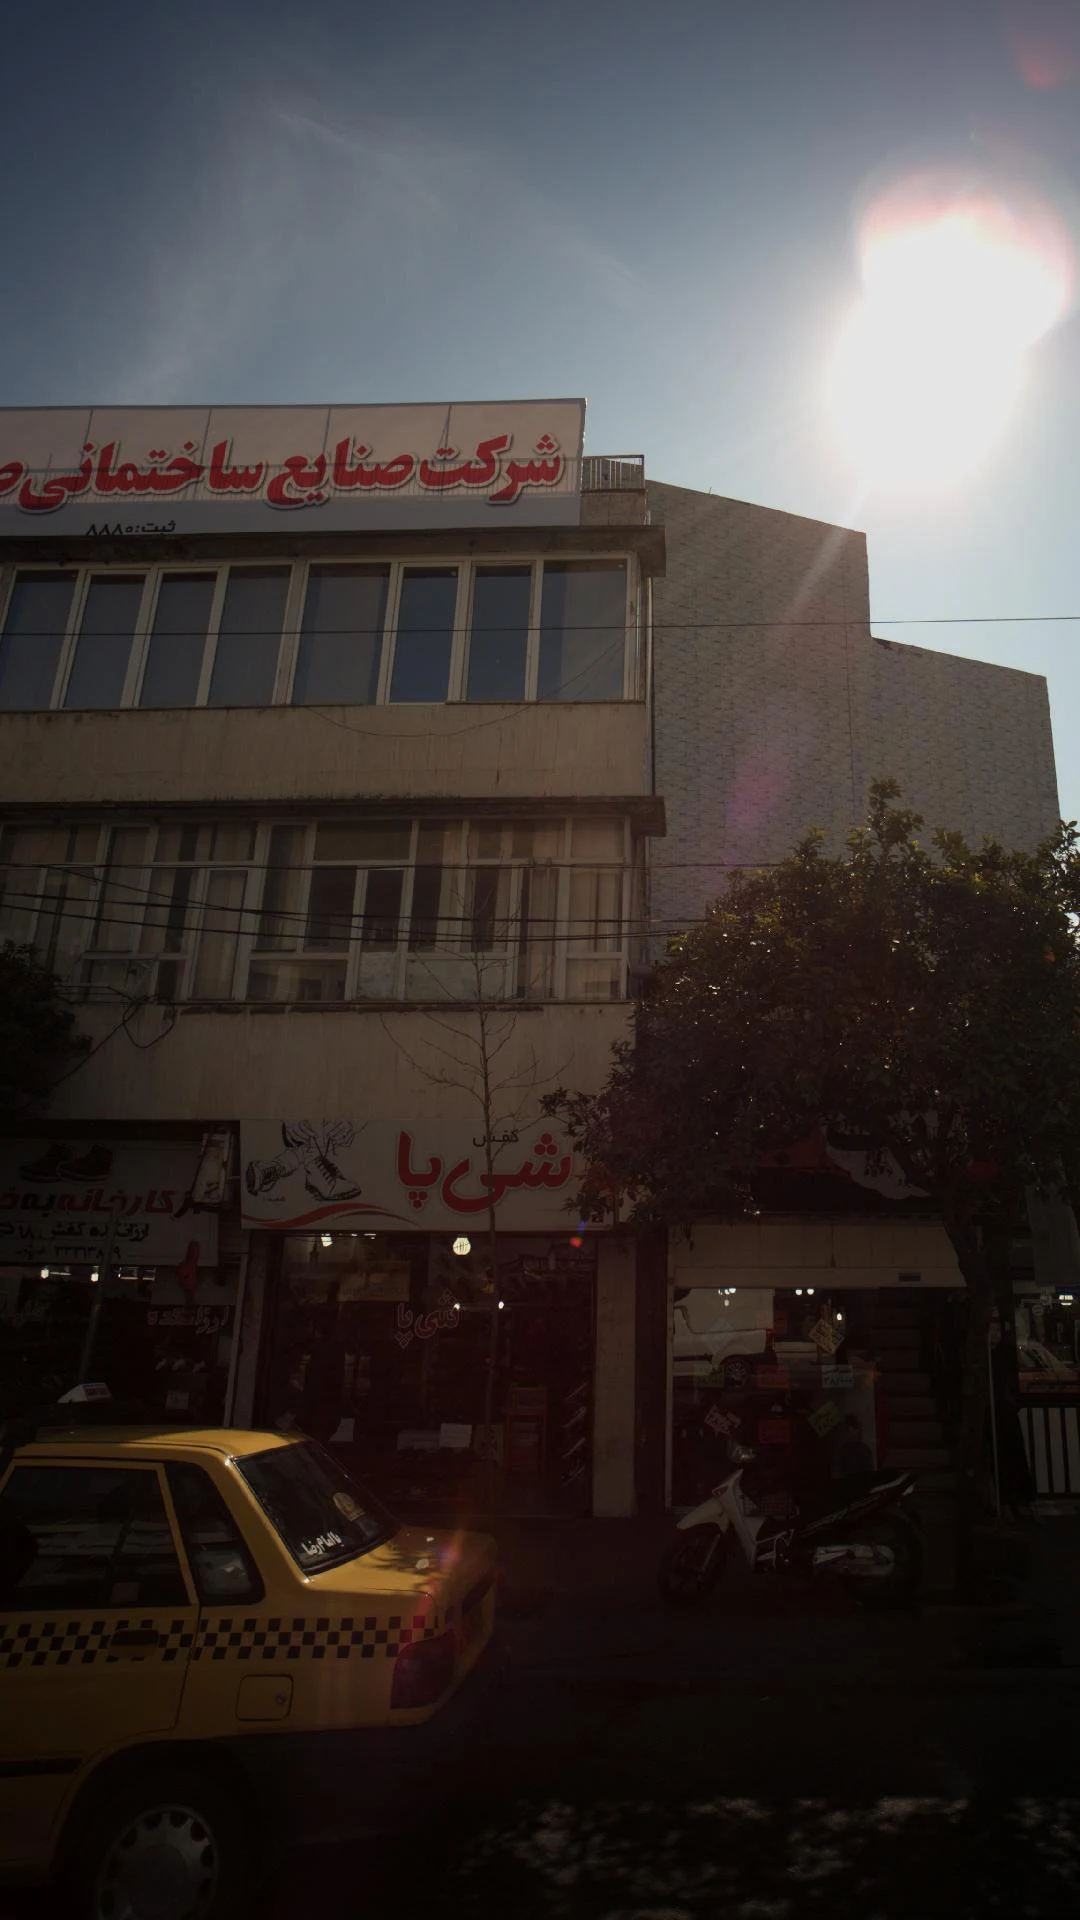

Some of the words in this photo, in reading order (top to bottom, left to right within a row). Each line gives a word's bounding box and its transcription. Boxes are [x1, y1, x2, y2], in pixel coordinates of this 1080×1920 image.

[18, 439, 264, 511] ساختمانی
[265, 436, 415, 506] صنایع
[419, 433, 562, 502] شرکت
[398, 1131, 442, 1209] پا
